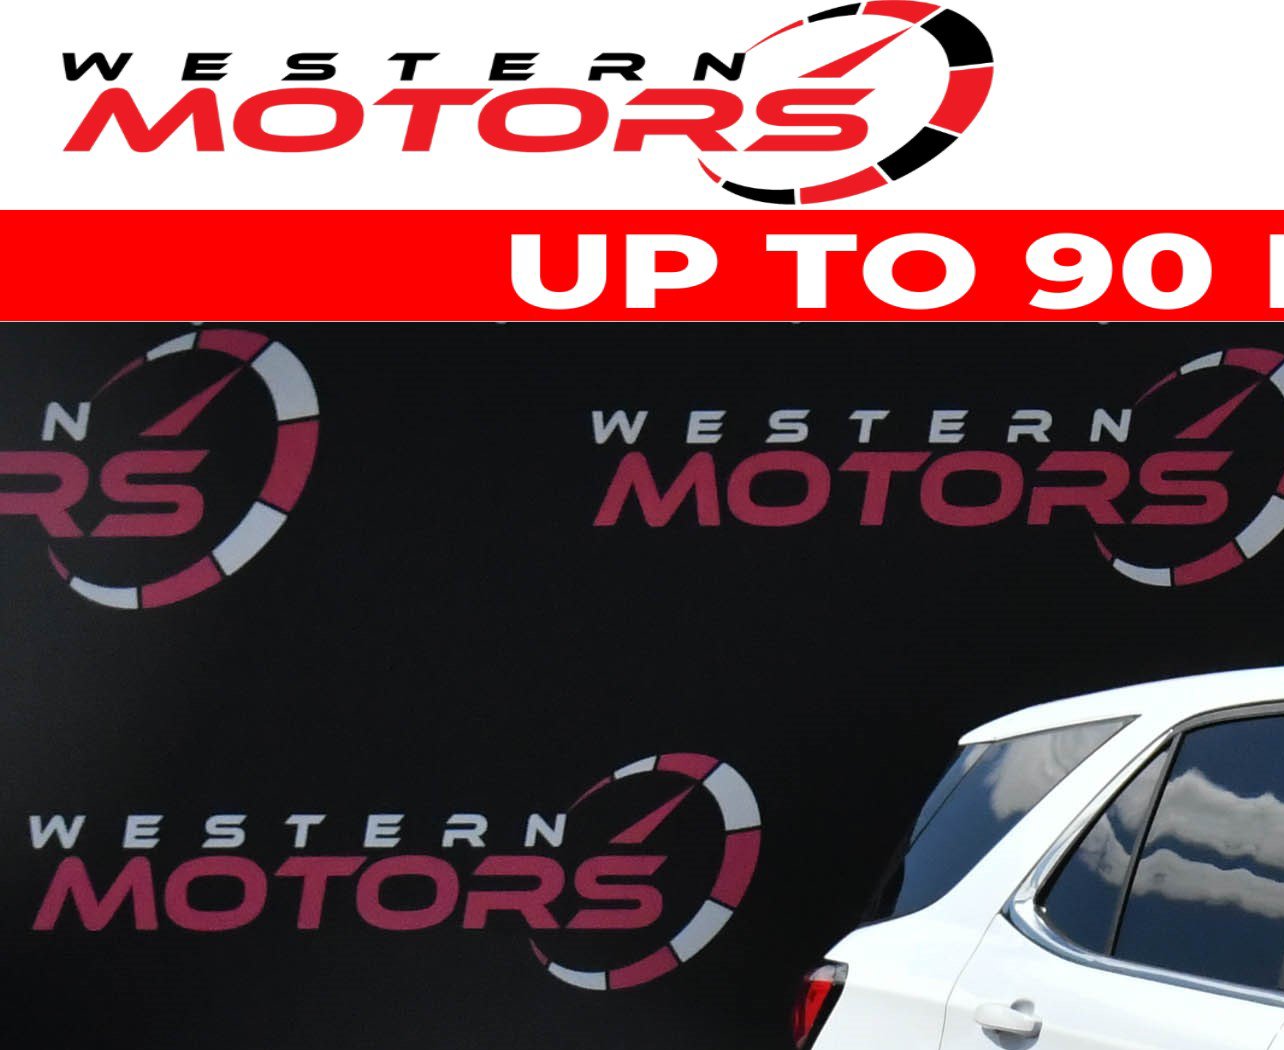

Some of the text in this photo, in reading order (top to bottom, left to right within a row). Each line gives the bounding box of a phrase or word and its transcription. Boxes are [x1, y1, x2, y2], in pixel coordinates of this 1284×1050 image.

[592, 408, 1132, 444] WESTERN
[593, 450, 1234, 527] MOTORS
[29, 813, 567, 849] WESTERN
[32, 855, 668, 932] MOTORS
